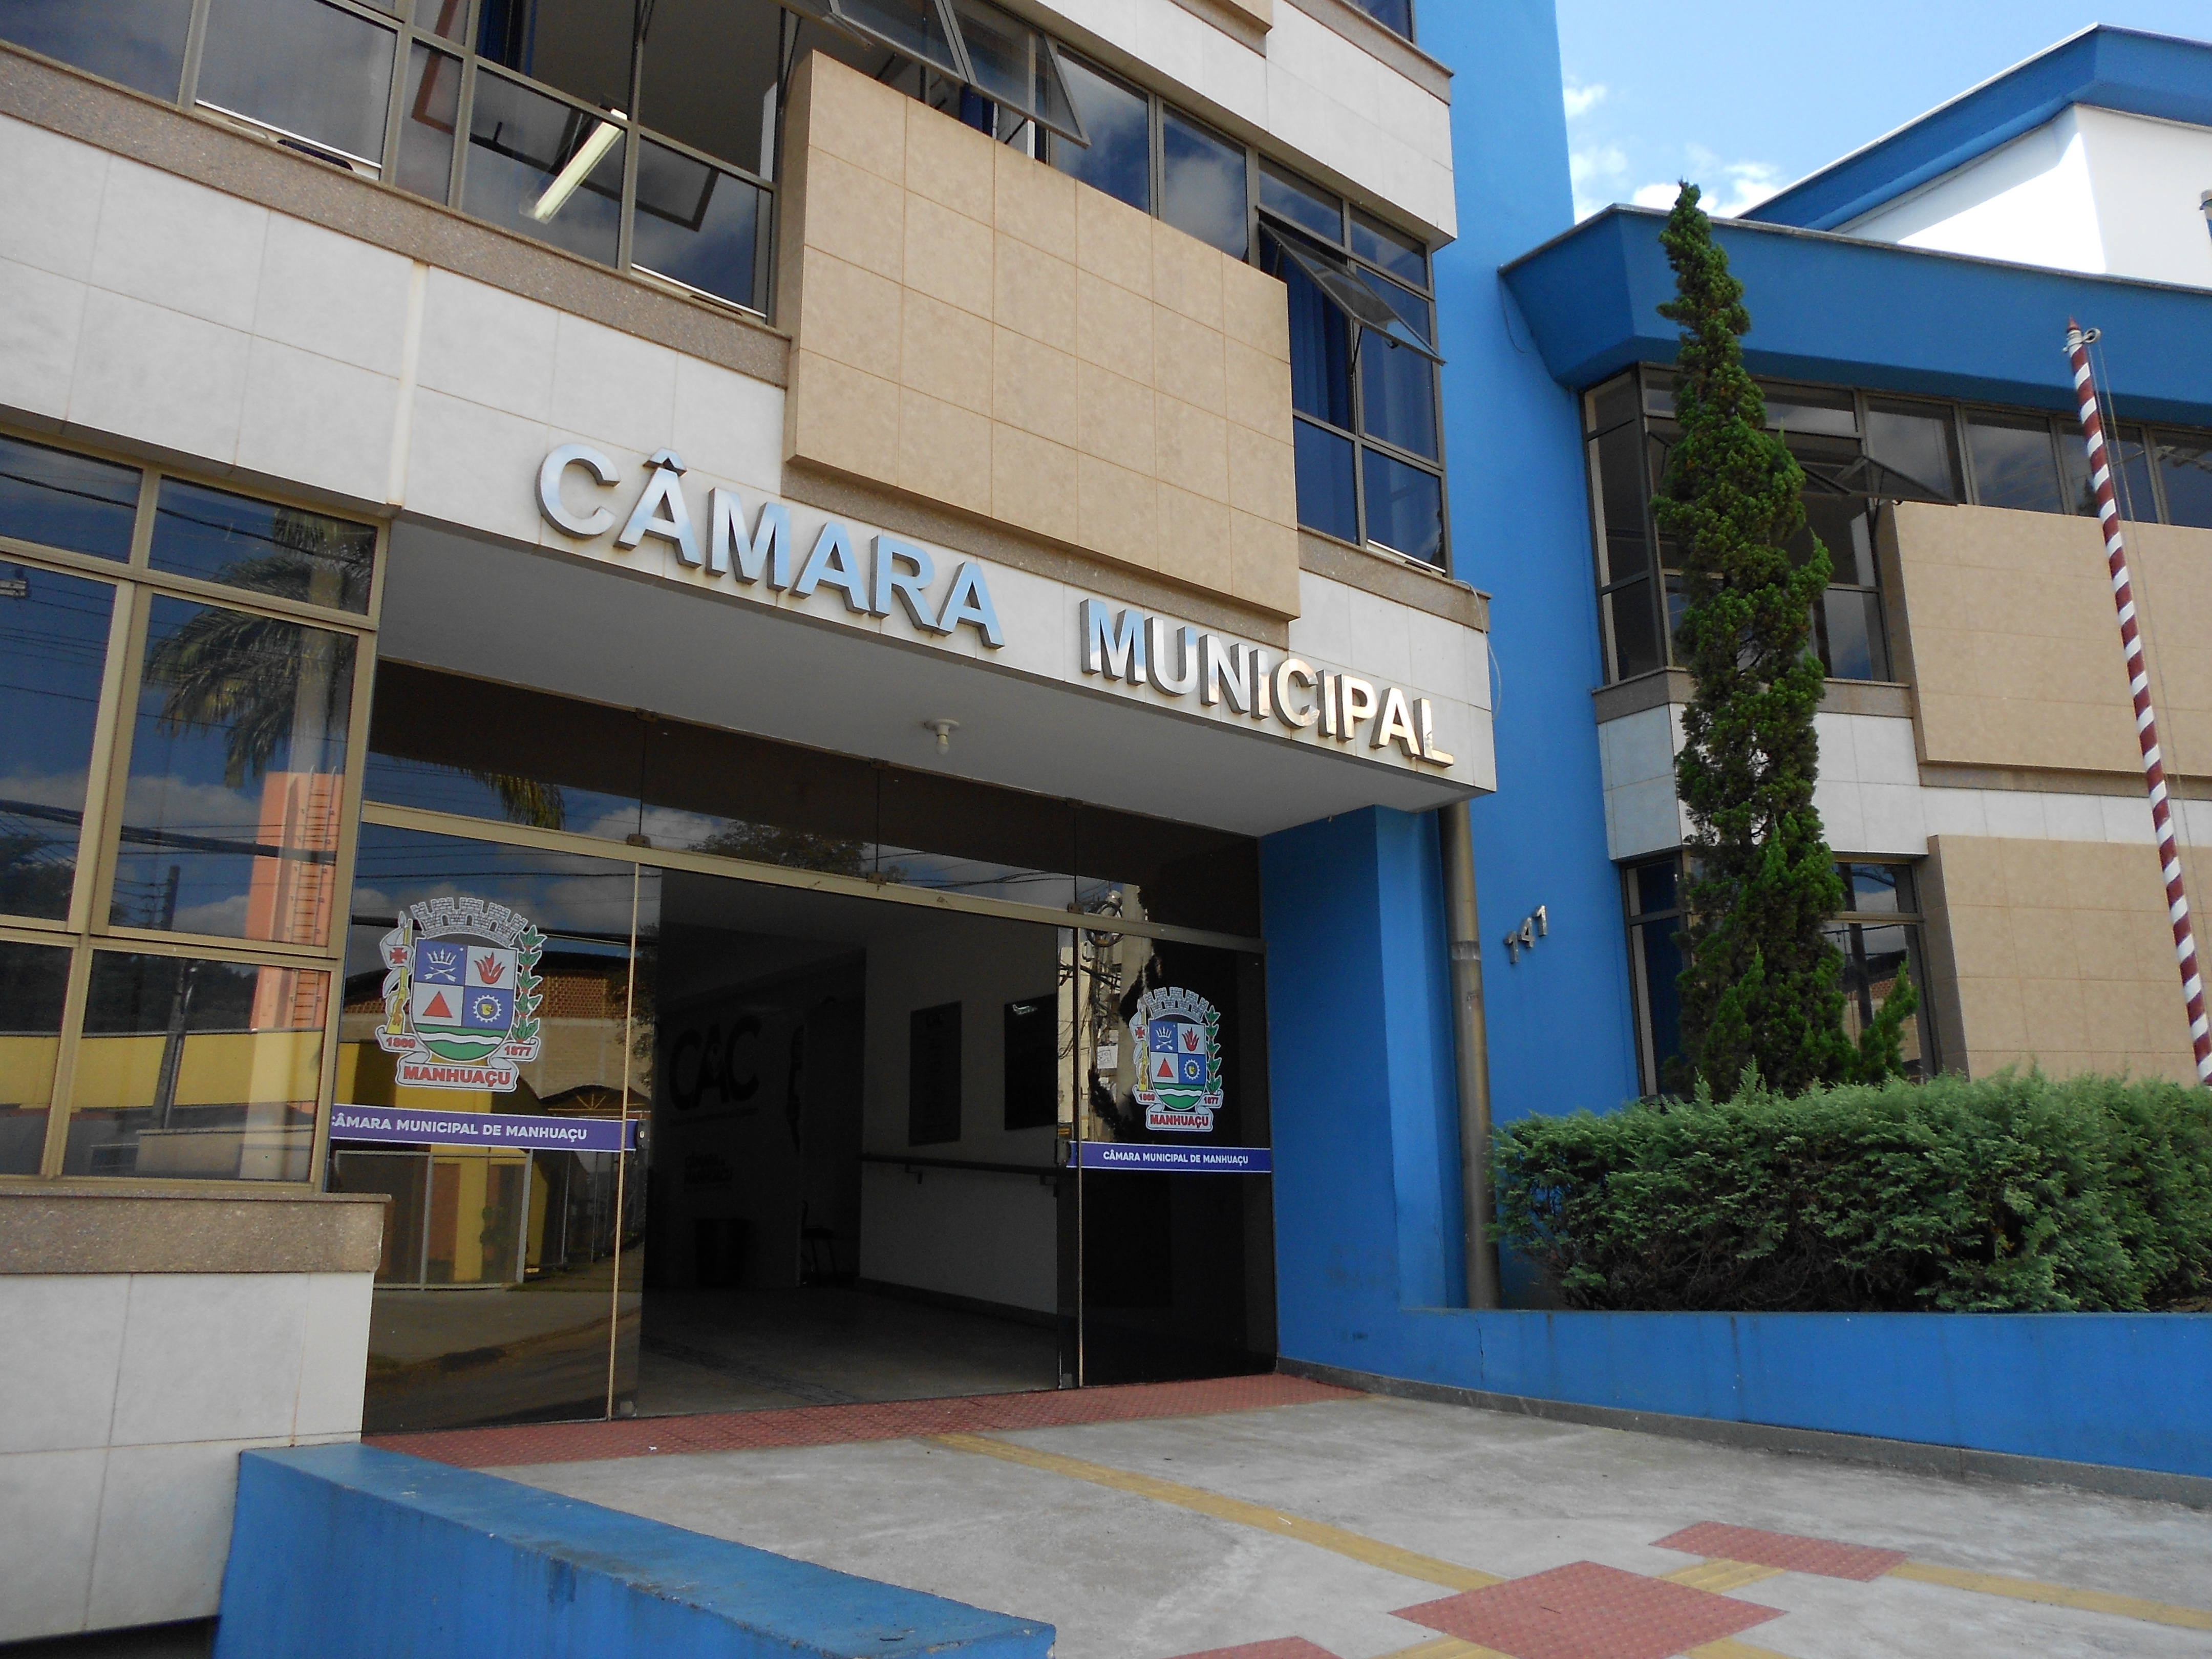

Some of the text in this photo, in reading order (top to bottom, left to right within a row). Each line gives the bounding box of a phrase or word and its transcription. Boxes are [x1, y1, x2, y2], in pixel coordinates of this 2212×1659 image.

[534, 442, 1454, 768] CÂMARA MUNICIPAL
[1503, 904, 1548, 964] 141
[403, 1066, 511, 1088] MANHUAÇU
[396, 1119, 479, 1135] MUNICIPAL
[482, 1124, 502, 1136] DE
[506, 1125, 587, 1142] MANHUAÇU
[1150, 1114, 1209, 1129] MANHUAÇU
[1103, 1149, 1249, 1166] CÂMARA MUNICIPAL DE MANHUAÇU
